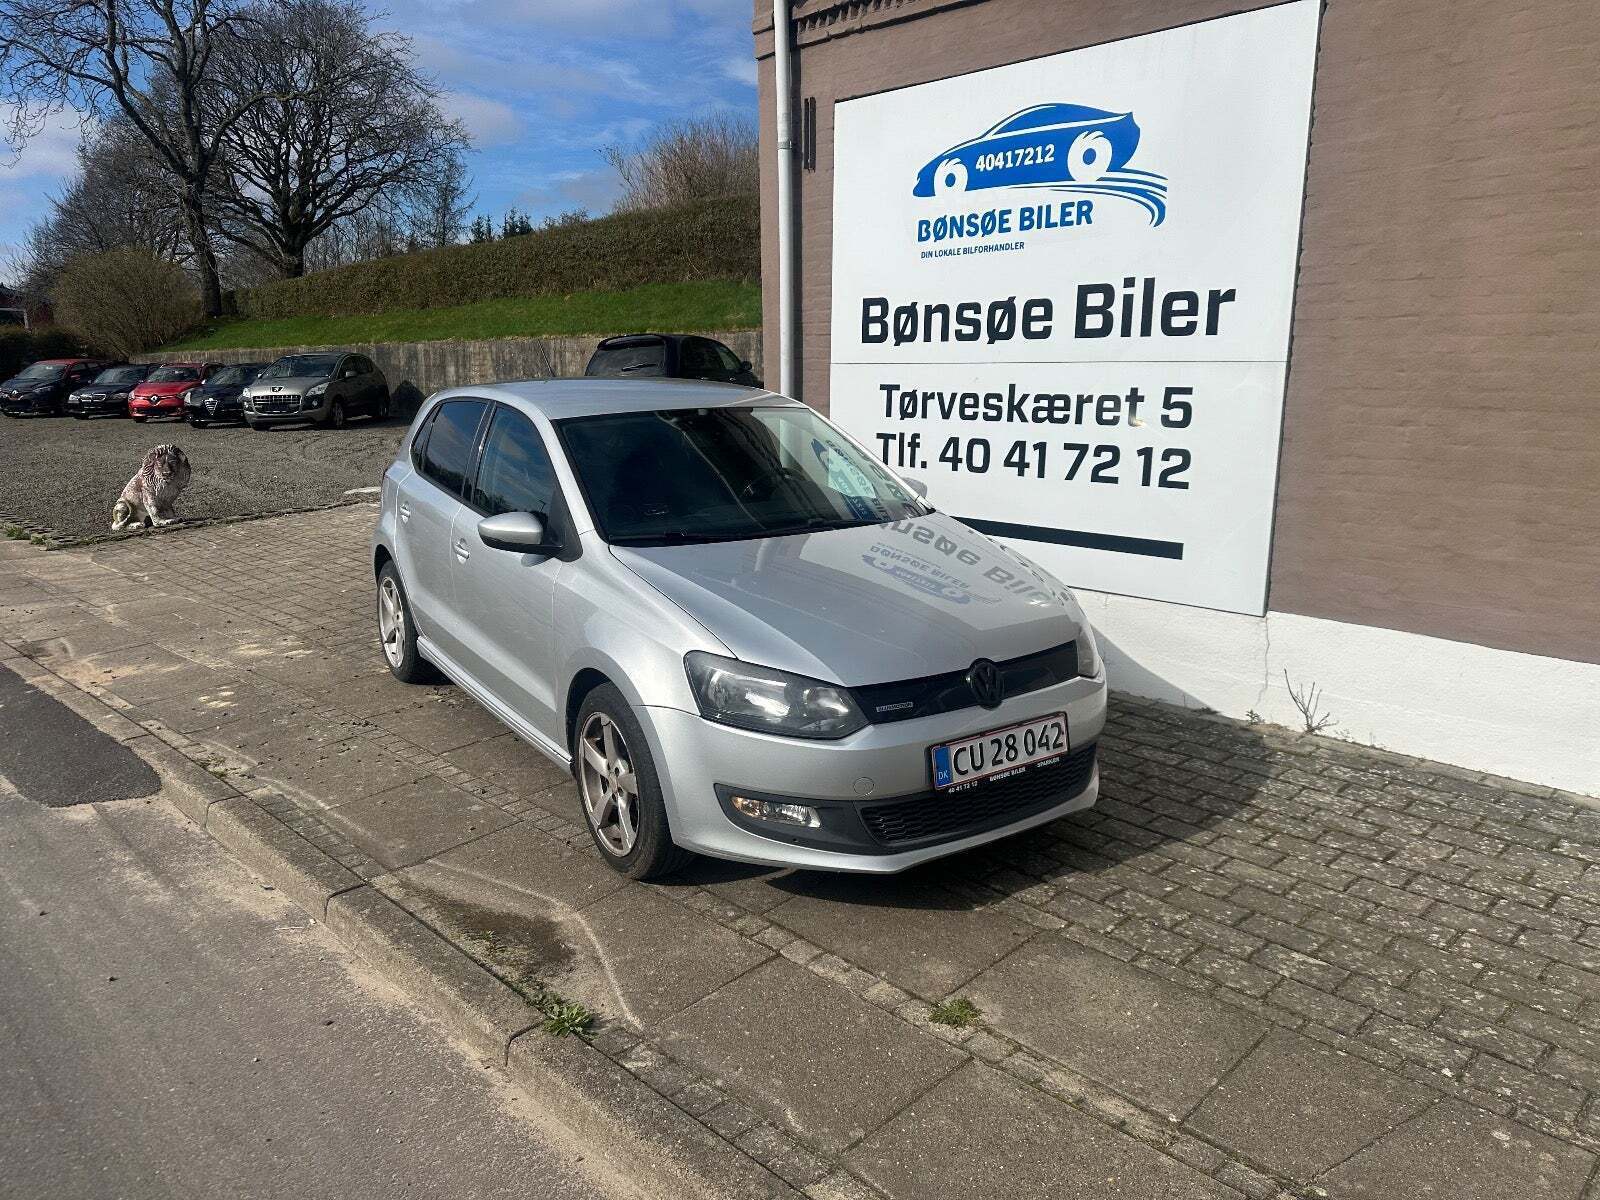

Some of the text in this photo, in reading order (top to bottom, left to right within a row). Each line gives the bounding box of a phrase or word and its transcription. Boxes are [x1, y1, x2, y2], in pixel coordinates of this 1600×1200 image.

[975, 143, 1055, 172] 40417212
[917, 199, 1094, 243] BØNSØE BILER
[920, 241, 1025, 259] DIN LOKALE BILFORHANDLER
[861, 276, 1237, 347] Bønsøe Biler
[879, 383, 1194, 429] Tørveskæret 5
[875, 431, 1192, 490] Tlf. 40 41 72 12
[953, 721, 1064, 776] CU 28 042
[938, 770, 949, 780] DK
